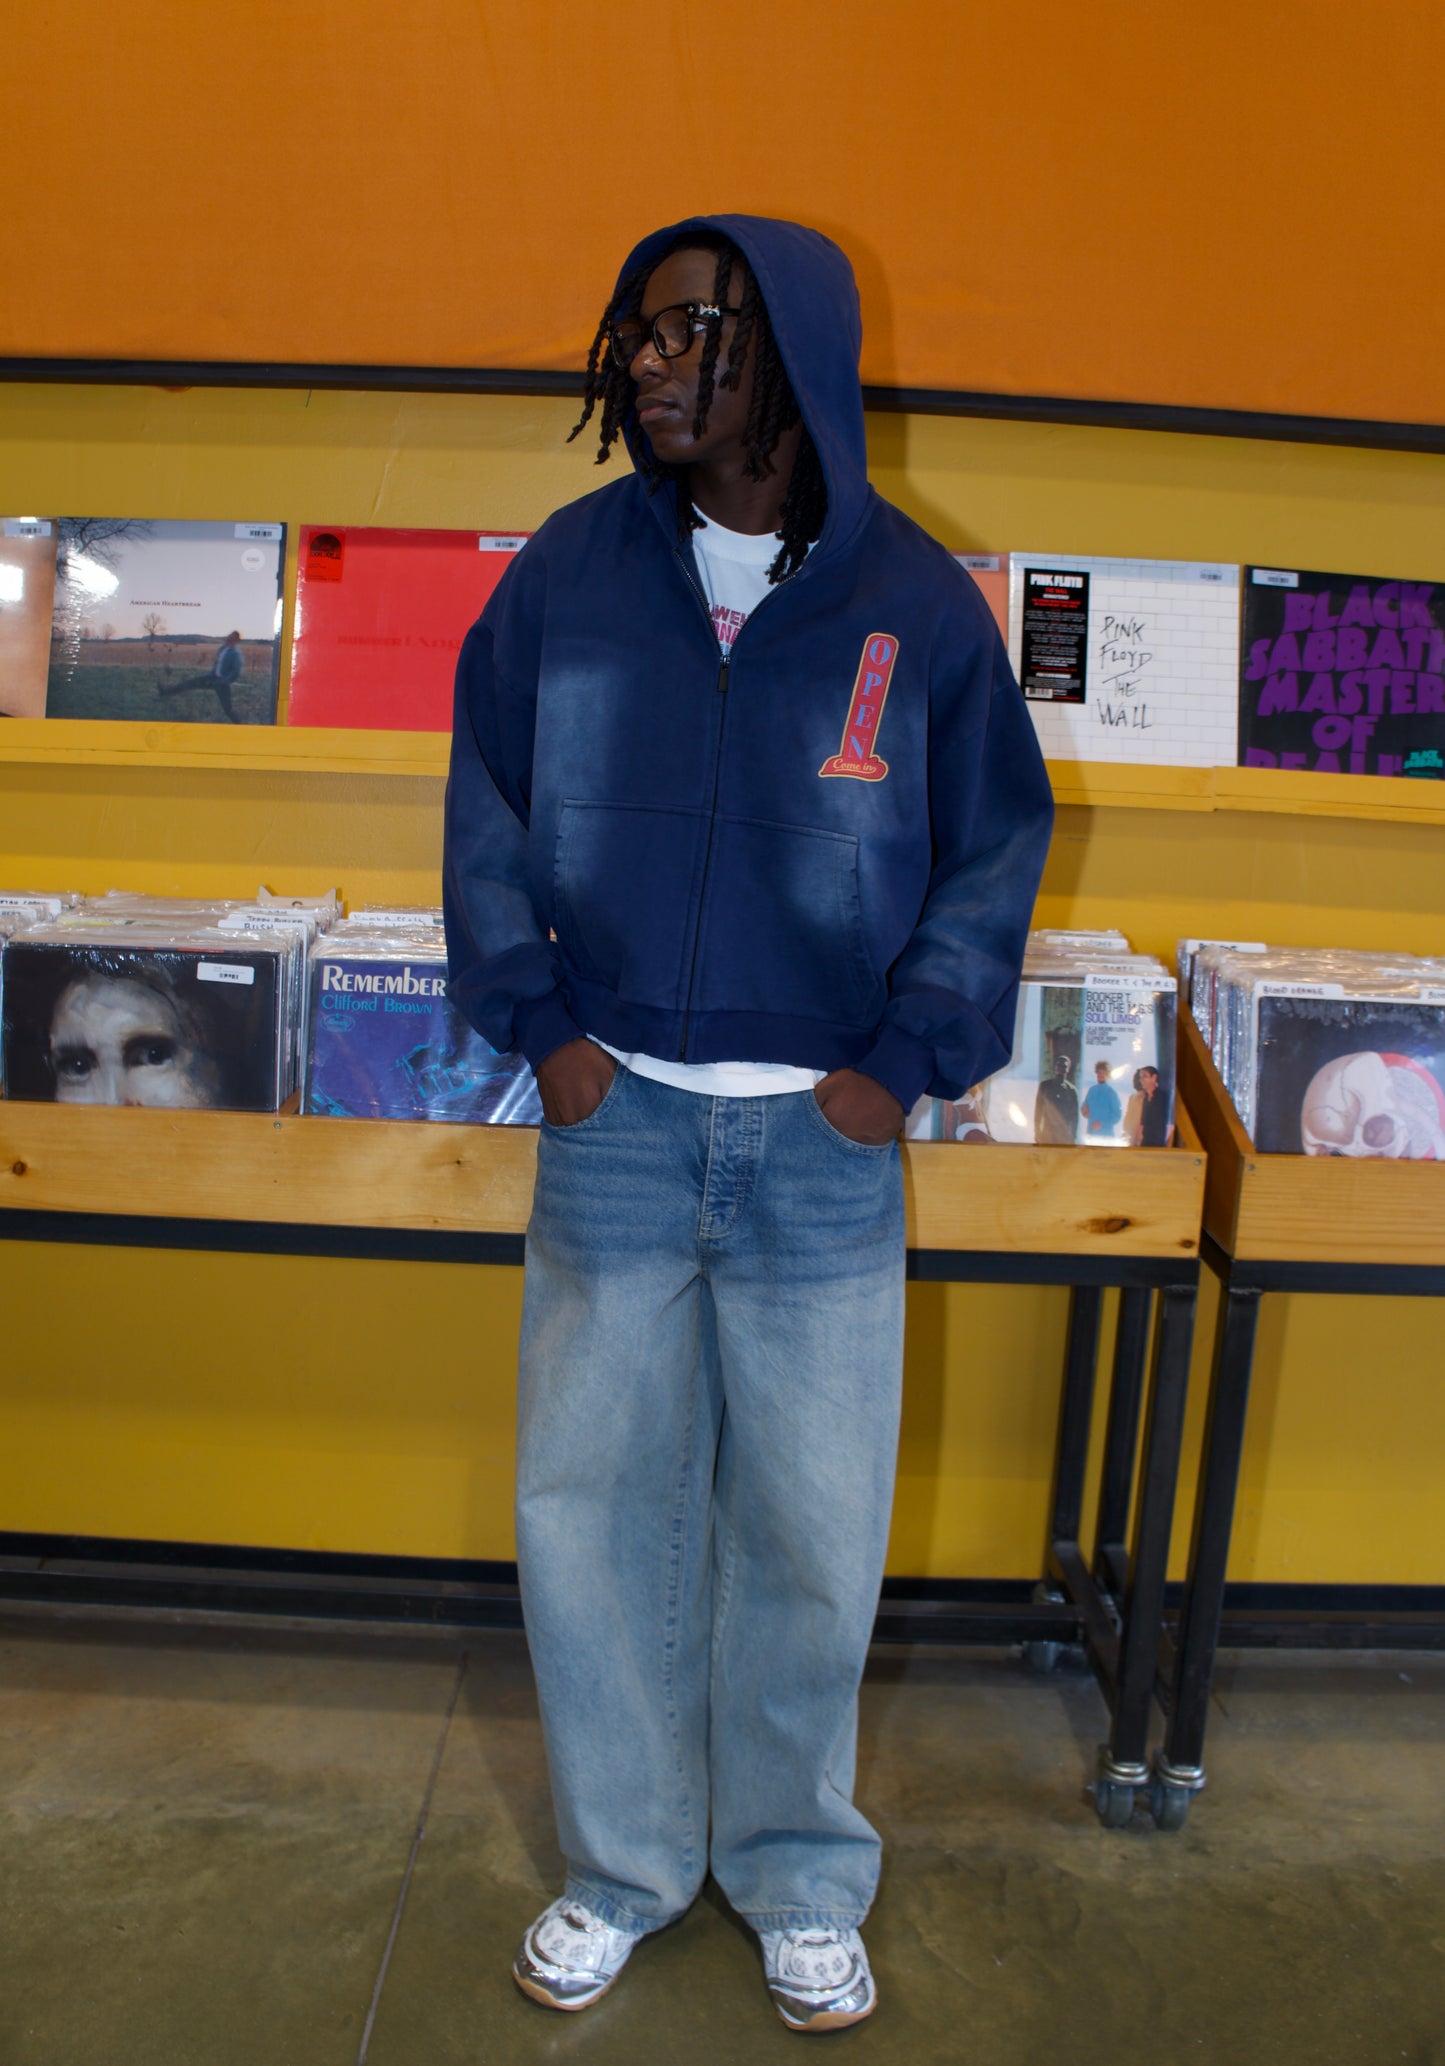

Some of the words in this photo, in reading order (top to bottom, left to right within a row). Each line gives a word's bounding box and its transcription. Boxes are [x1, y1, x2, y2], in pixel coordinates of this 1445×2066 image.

[1283, 583, 1435, 633] BLACK
[1099, 616, 1146, 645] PINK
[1099, 639, 1153, 673] FLOYD
[1245, 627, 1445, 681] SABBATH
[1102, 669, 1142, 698] THE
[1257, 669, 1445, 717] MASTER
[847, 639, 891, 760] OPEN
[1096, 698, 1152, 729] WALL
[1311, 715, 1379, 753] OF
[832, 758, 861, 771] Come
[384, 998, 433, 1014] BROWN
[1086, 991, 1123, 1003] BOOKER
[1086, 1002, 1106, 1013] AND
[1107, 1002, 1125, 1014] THE
[1085, 1012, 1109, 1024] SOUL
[1111, 1014, 1141, 1026] LIMBO
